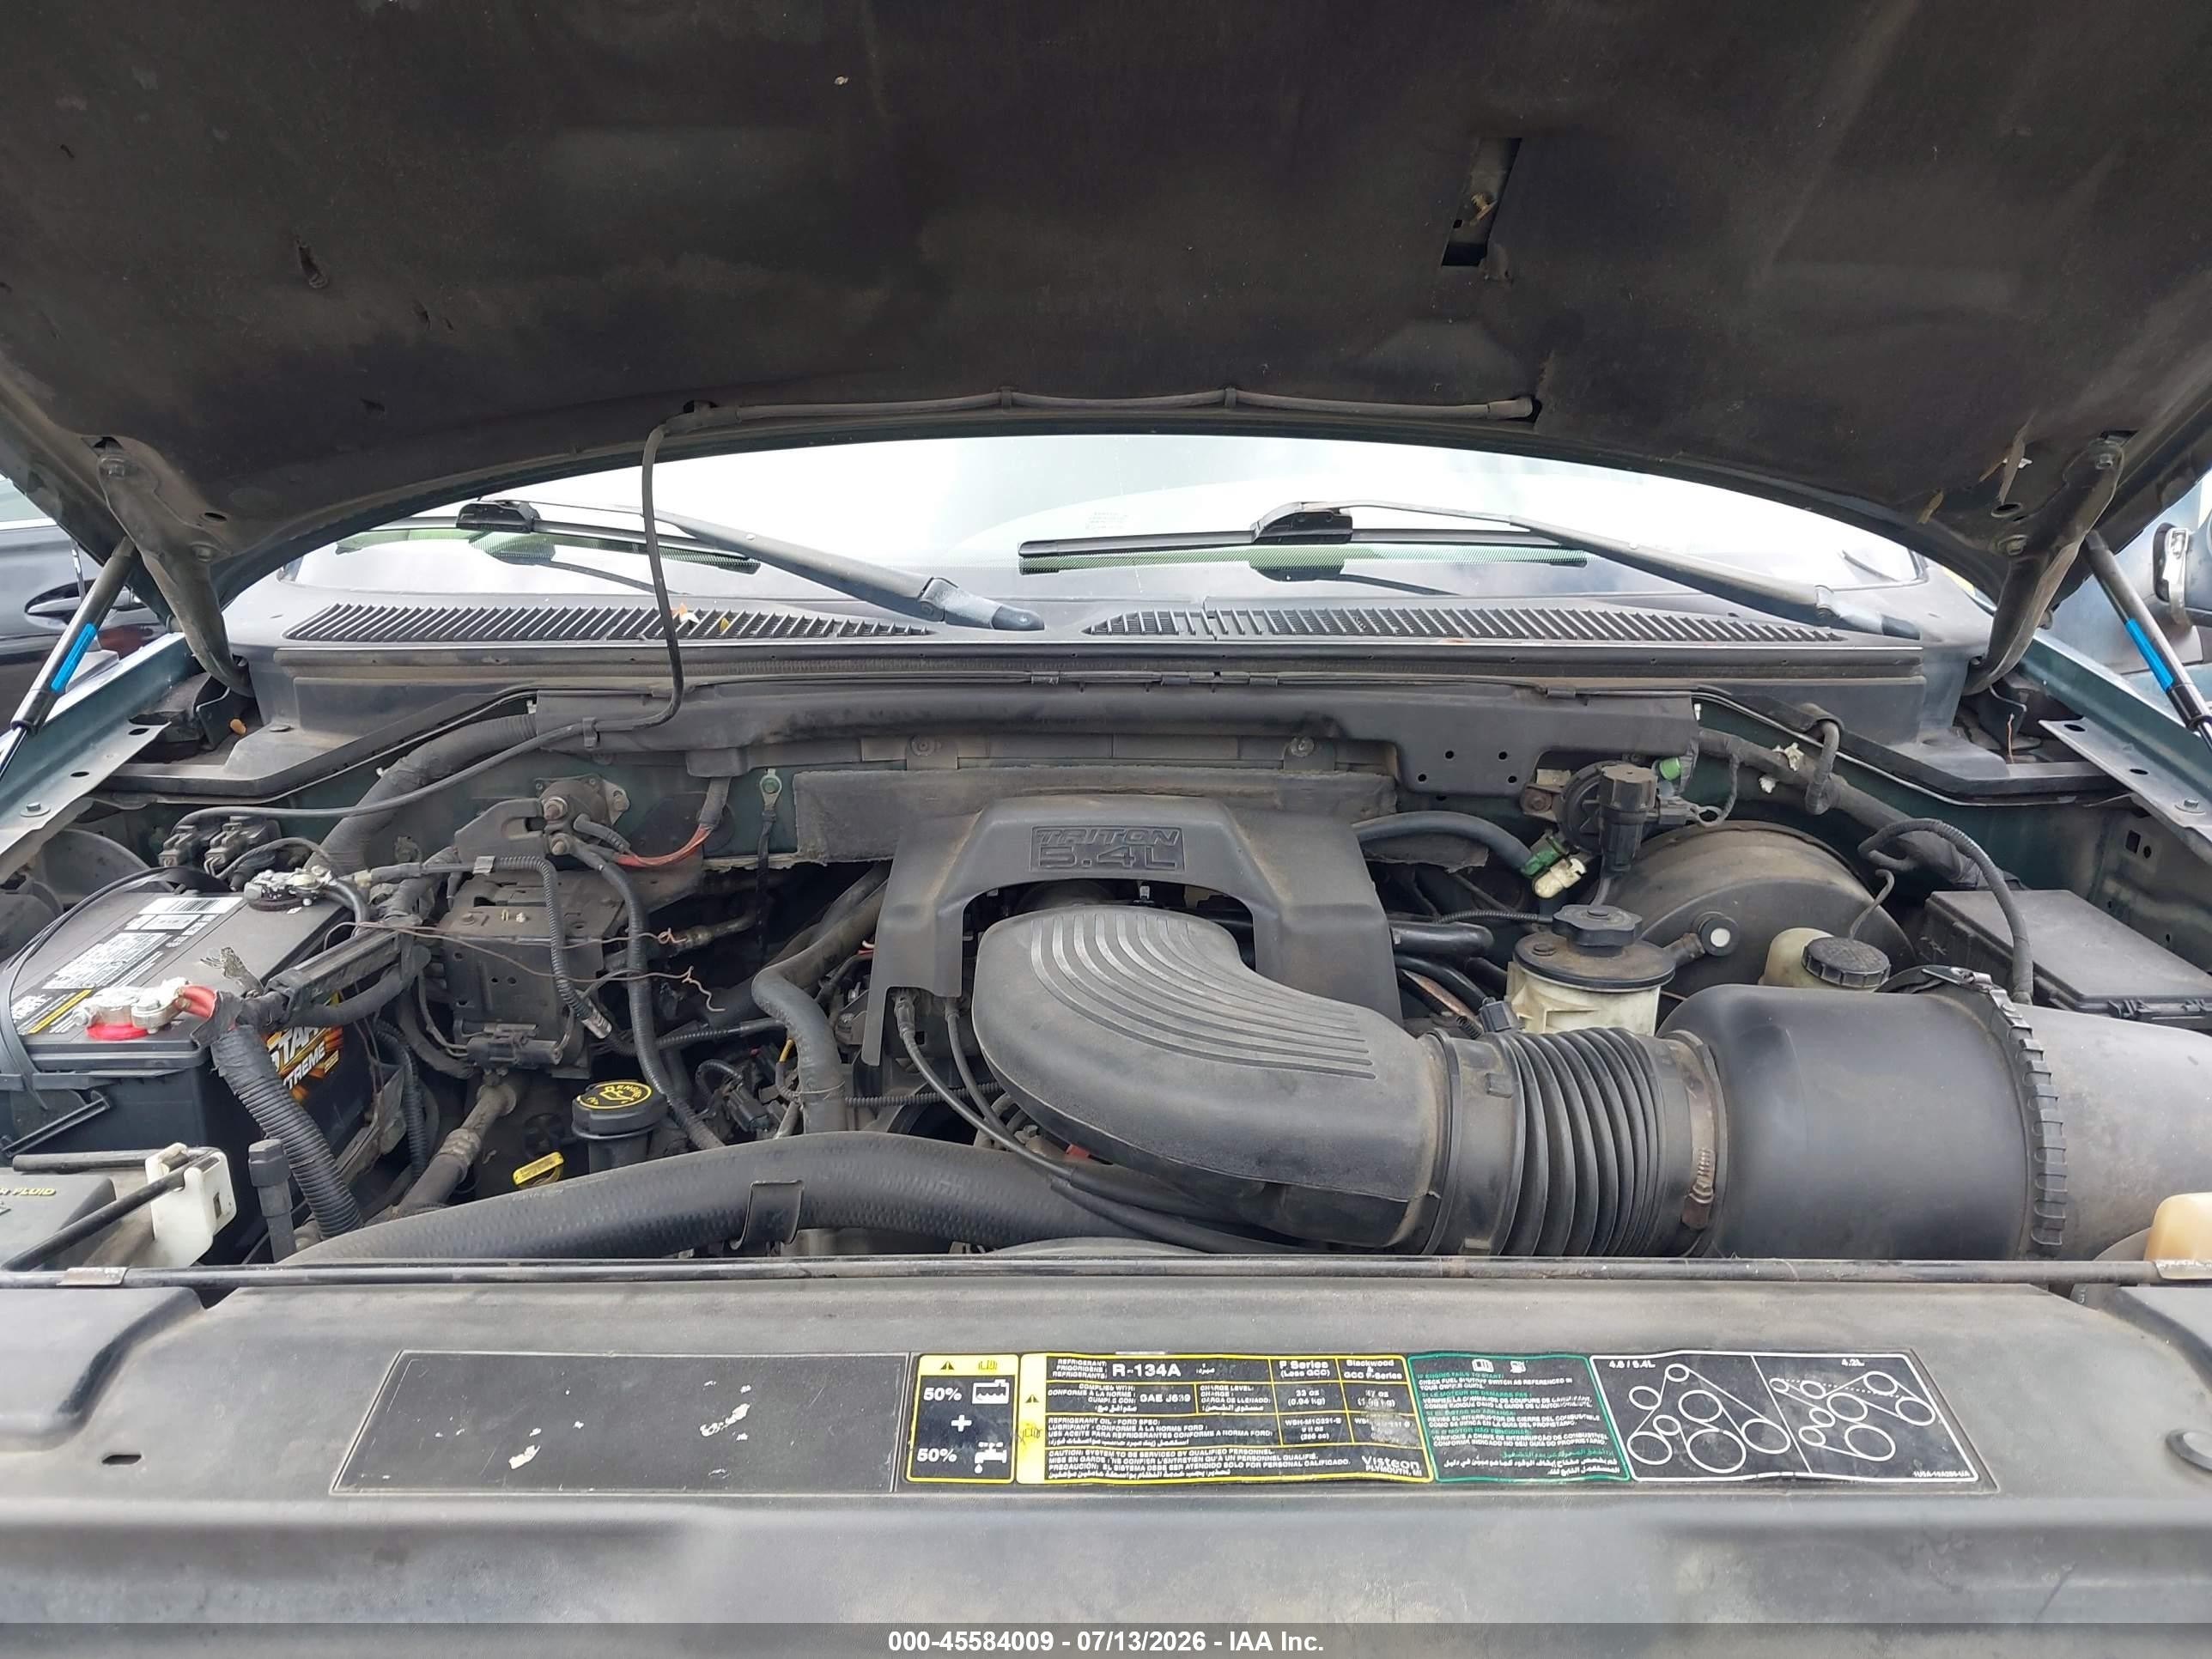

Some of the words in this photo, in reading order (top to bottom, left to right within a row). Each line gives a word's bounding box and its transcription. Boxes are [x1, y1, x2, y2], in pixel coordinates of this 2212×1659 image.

[1036, 829, 1180, 845] TRITON
[1039, 845, 1177, 870] 5.4L
[13, 1188, 57, 1196] FLUID
[1112, 1363, 1182, 1377] R-134A
[1290, 1360, 1329, 1370] Series
[1280, 1370, 1305, 1378] (Less
[1306, 1369, 1330, 1377] GCC)
[923, 1387, 963, 1401] 50%
[917, 1448, 957, 1462] 50%
[1362, 1455, 1420, 1470] Visteon
[1366, 1464, 1412, 1476] PLYMOUTH,
